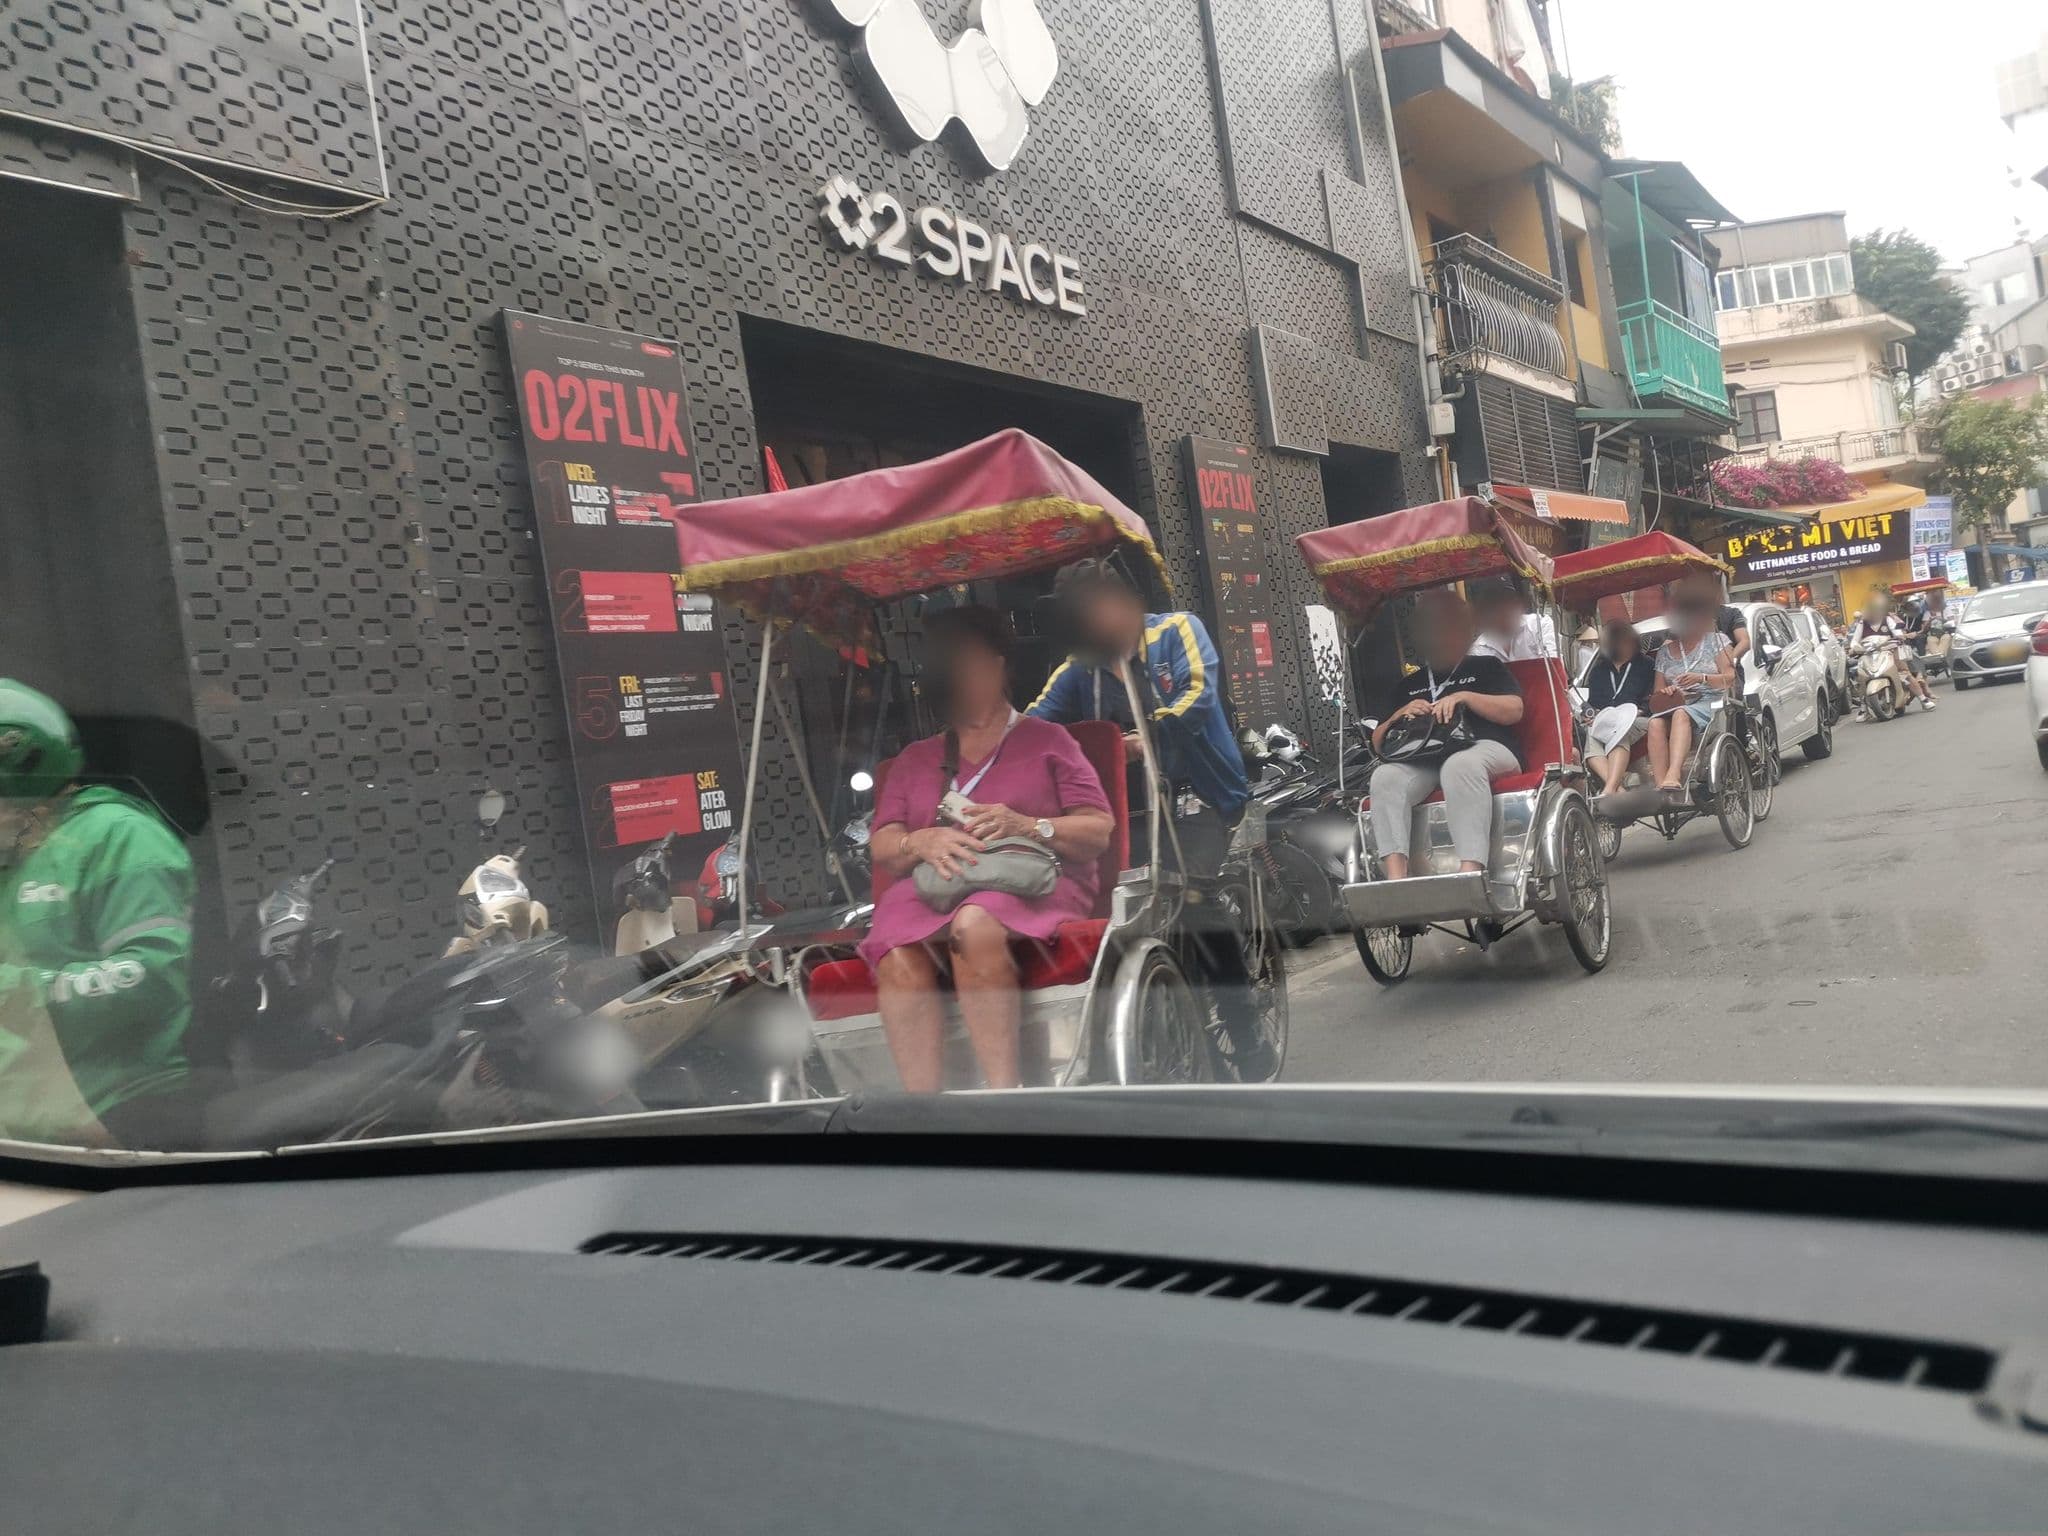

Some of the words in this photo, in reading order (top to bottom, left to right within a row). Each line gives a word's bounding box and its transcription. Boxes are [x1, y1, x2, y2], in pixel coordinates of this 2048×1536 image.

[914, 207, 1086, 316] SPACE
[568, 484, 610, 505] LADIES
[571, 506, 607, 525] NIGHT
[1748, 555, 1809, 571] VIETNAMESE
[1811, 550, 1838, 562] FOOD
[1840, 547, 1847, 557] &
[1849, 543, 1881, 555] BREAD
[624, 695, 643, 708] LAST
[619, 709, 645, 722] FRIDAY
[625, 723, 648, 736] NIGHT
[696, 770, 719, 790] SAT:
[700, 790, 726, 810] ATER
[702, 810, 731, 831] GLOW
